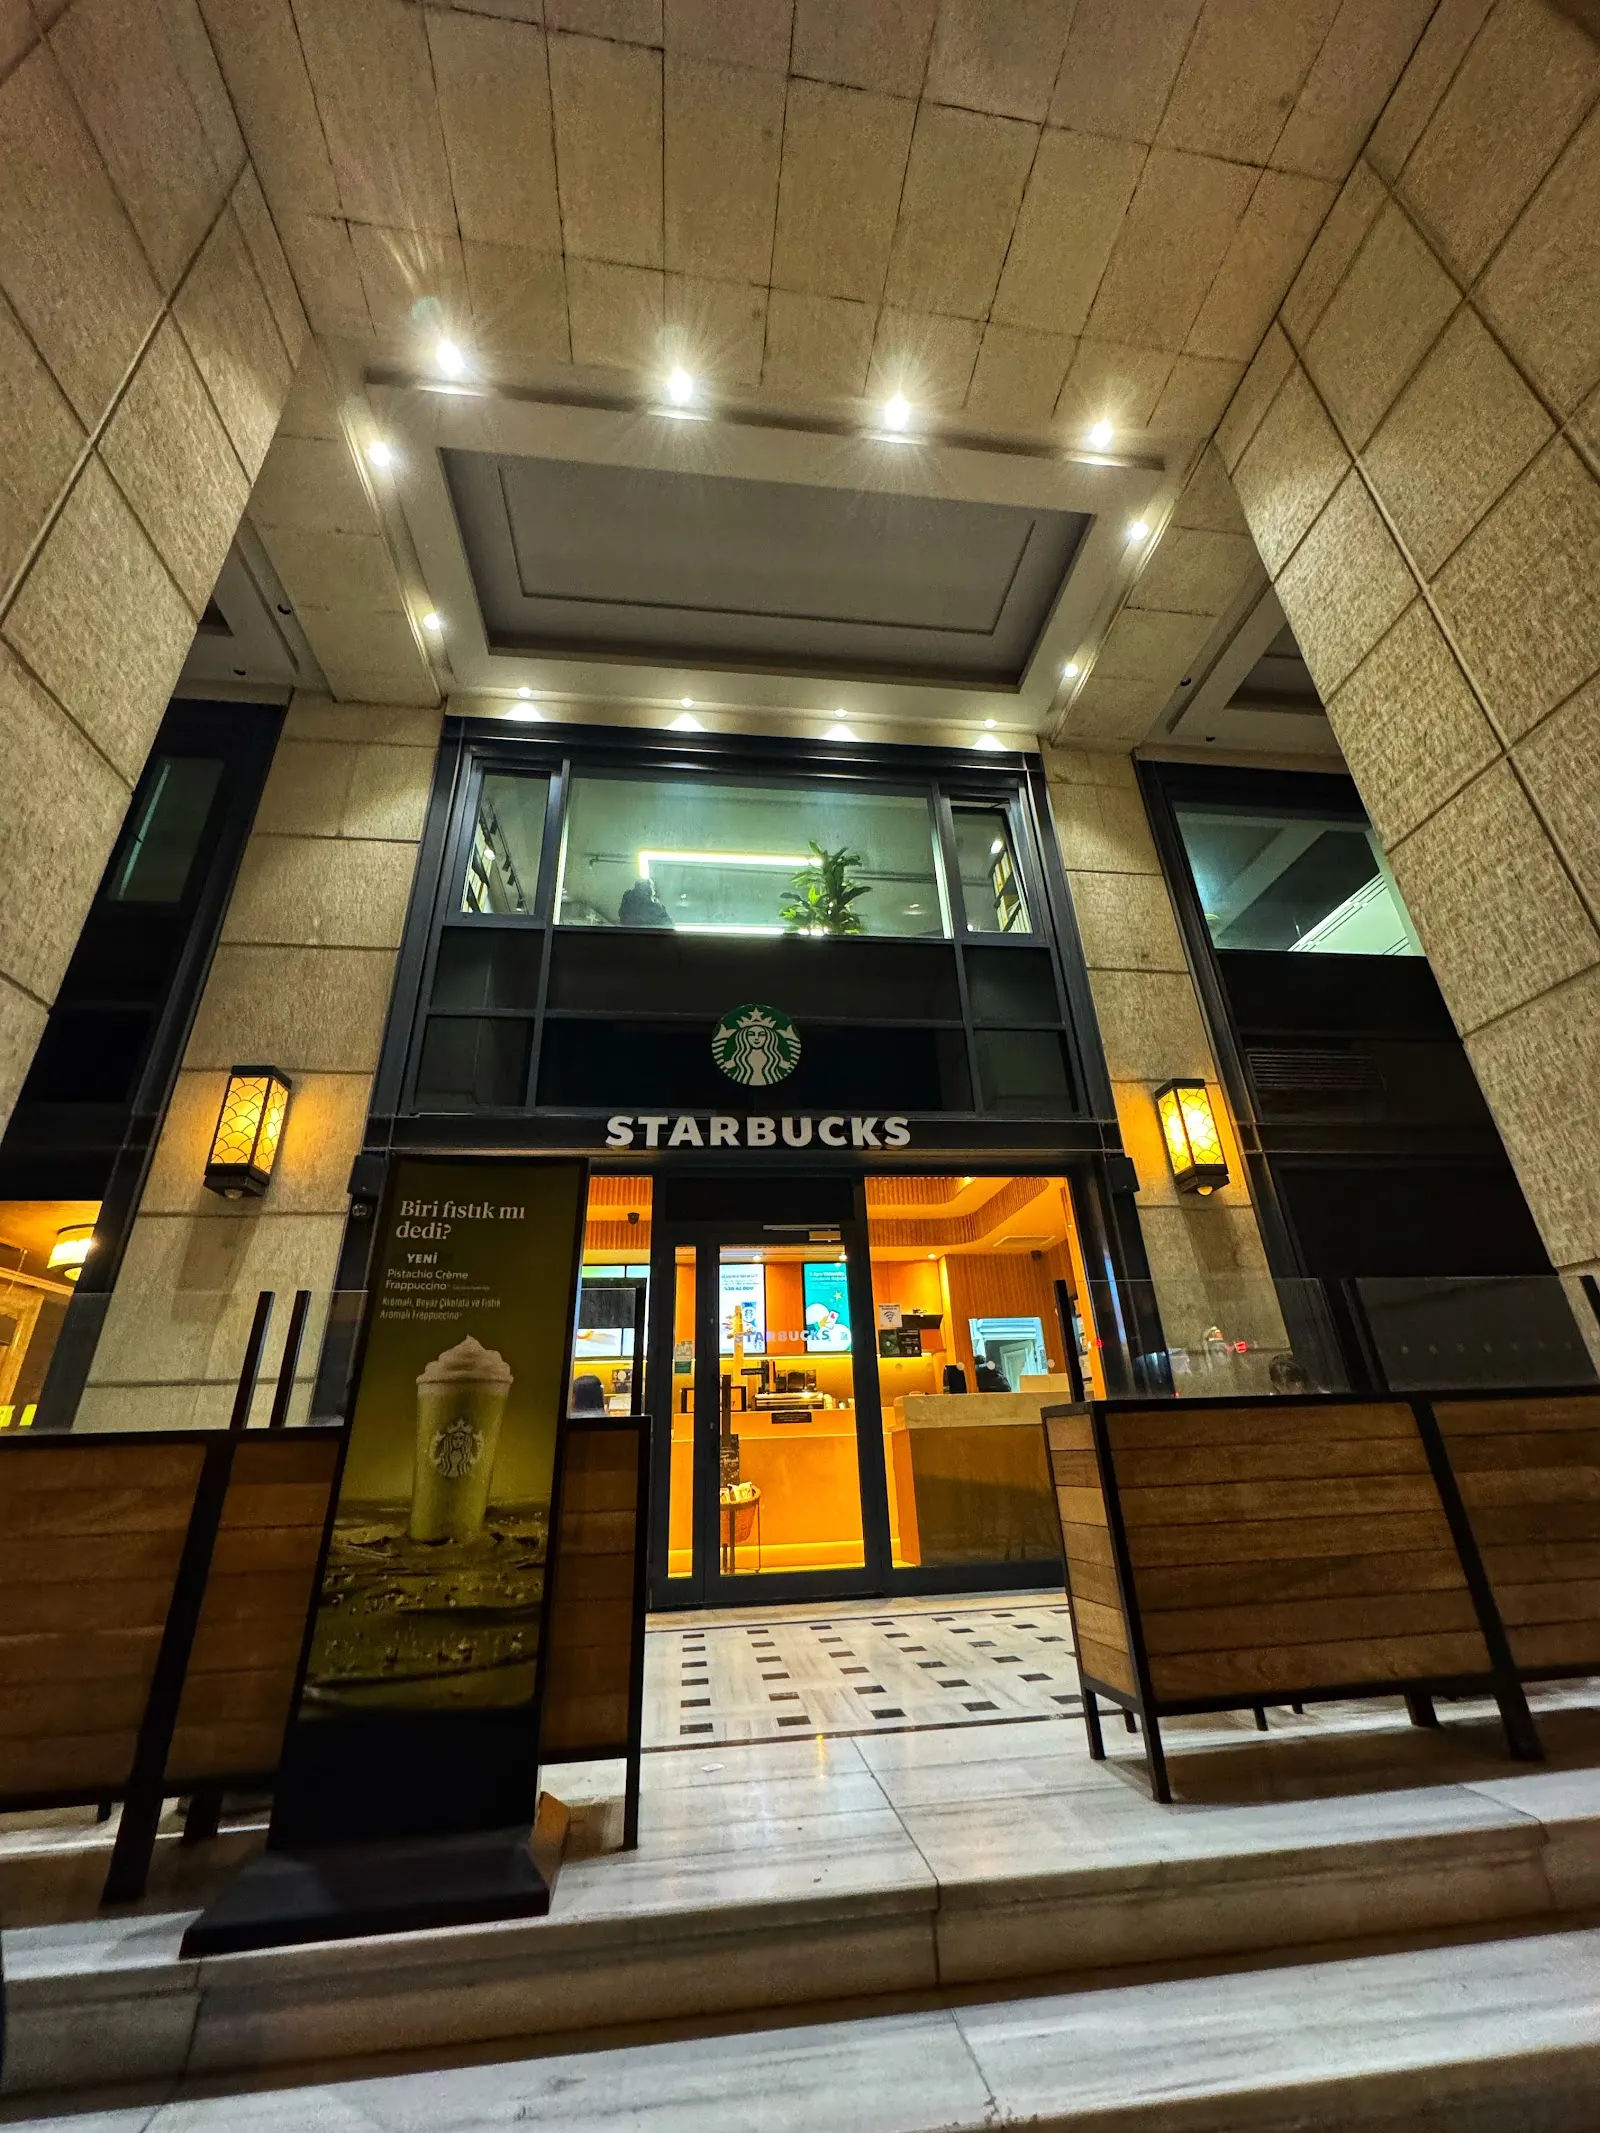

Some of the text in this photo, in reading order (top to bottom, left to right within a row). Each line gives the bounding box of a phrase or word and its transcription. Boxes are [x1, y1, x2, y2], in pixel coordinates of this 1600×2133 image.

[605, 1115, 911, 1148] STARBUCKS
[400, 1199, 526, 1219] Biri fıstık mı
[395, 1220, 452, 1240] dedi?
[407, 1251, 438, 1264] YENİ
[387, 1268, 469, 1280] Pistachio Crème
[416, 1298, 438, 1308] Beyaz
[439, 1297, 469, 1309] Çikolata
[471, 1299, 480, 1308] ve
[734, 1329, 830, 1343] STARBUCKS
